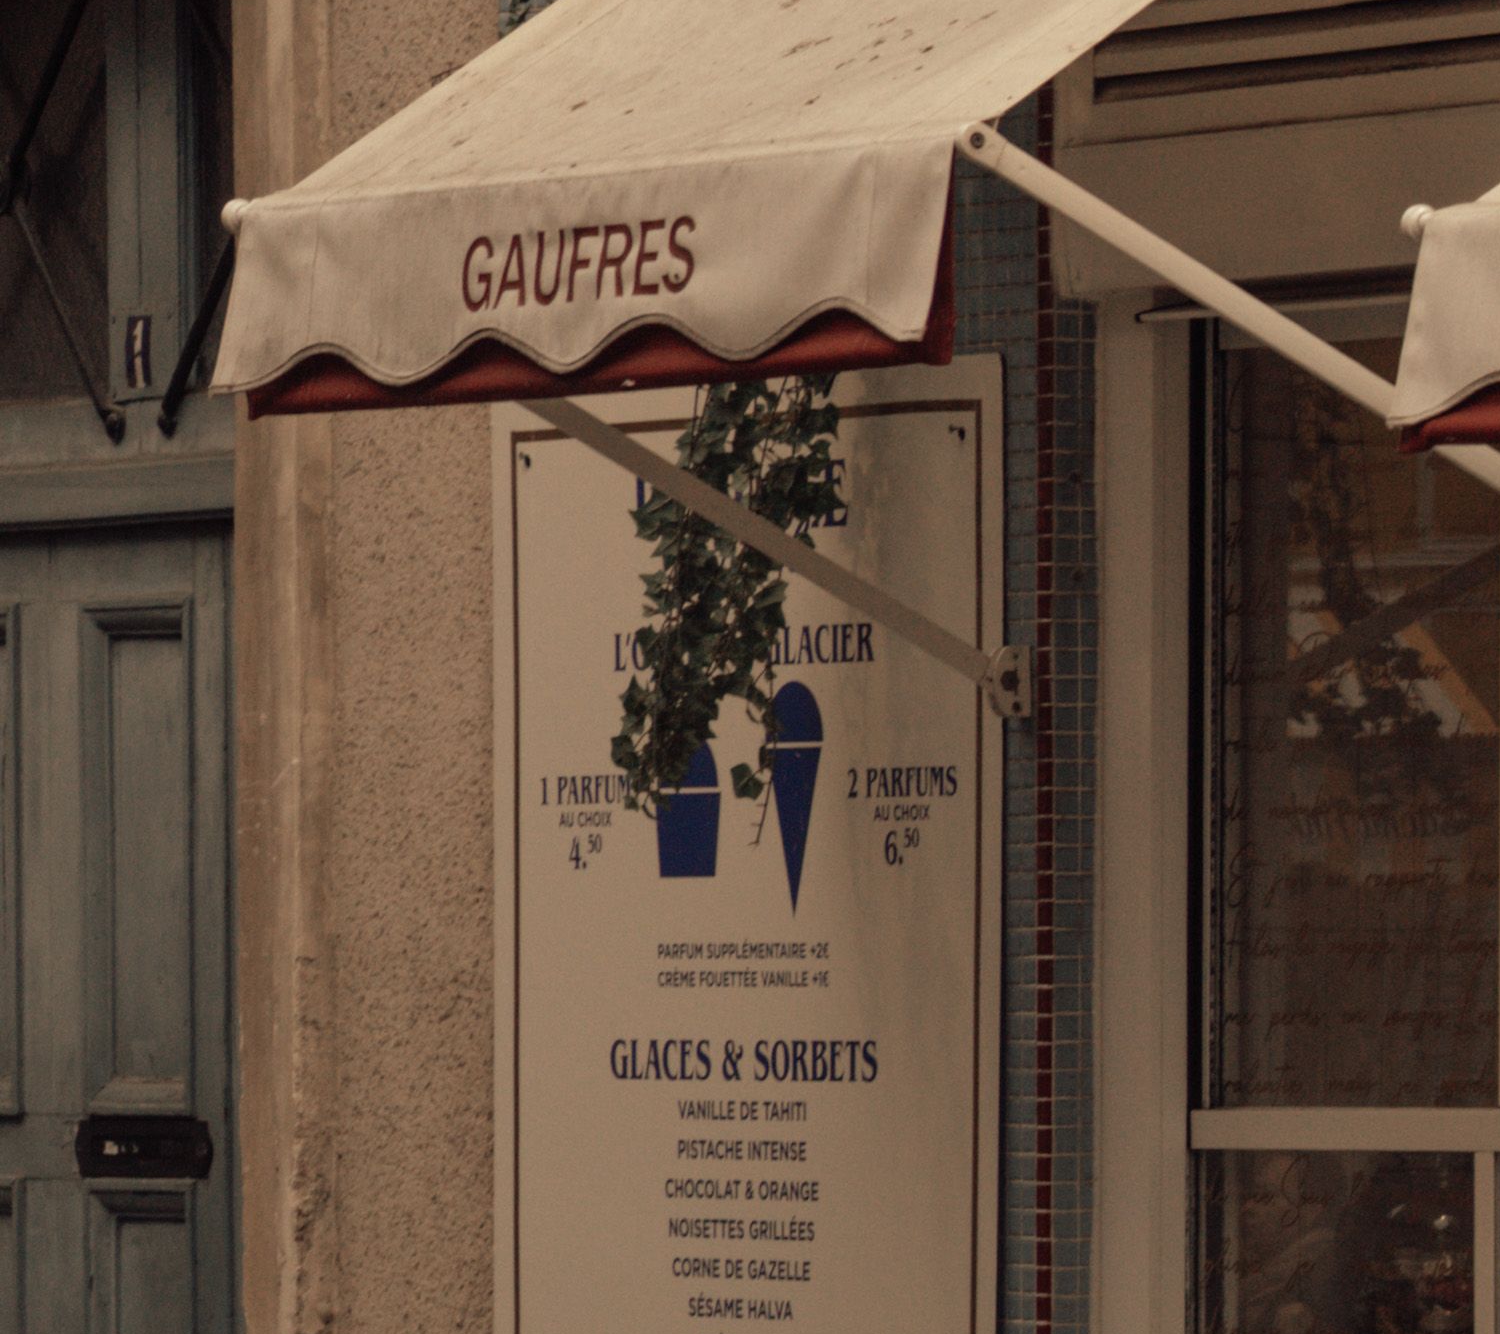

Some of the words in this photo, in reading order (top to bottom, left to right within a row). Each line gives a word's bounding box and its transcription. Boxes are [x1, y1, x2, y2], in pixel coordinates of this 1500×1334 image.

[462, 216, 696, 313] GAUFRES
[539, 775, 550, 808] 1
[556, 772, 632, 808] PARFUM
[847, 766, 859, 800] 2
[865, 764, 958, 798] PARFUMS
[568, 833, 604, 870] 4.50
[884, 826, 920, 868] 6.50
[609, 1038, 713, 1082] GLACES
[721, 1039, 745, 1082] &
[753, 1038, 880, 1084] SORBETS
[677, 1099, 736, 1122] VANILLE
[739, 1100, 759, 1122] DE
[762, 1100, 807, 1121] TAHITI
[677, 1138, 744, 1161] PISTACHE
[747, 1139, 807, 1163] INTENSE
[664, 1177, 742, 1200] CHOCOLAT
[744, 1179, 755, 1201] &
[757, 1179, 820, 1203] ORANGE
[668, 1217, 745, 1240] NOISETTES
[748, 1216, 816, 1243] GRILLÉES
[671, 1256, 721, 1279] CORNE
[724, 1258, 744, 1280] DE
[747, 1259, 812, 1283] GAZELLE
[688, 1292, 744, 1320] SÉSAME
[747, 1299, 794, 1321] HALVA
